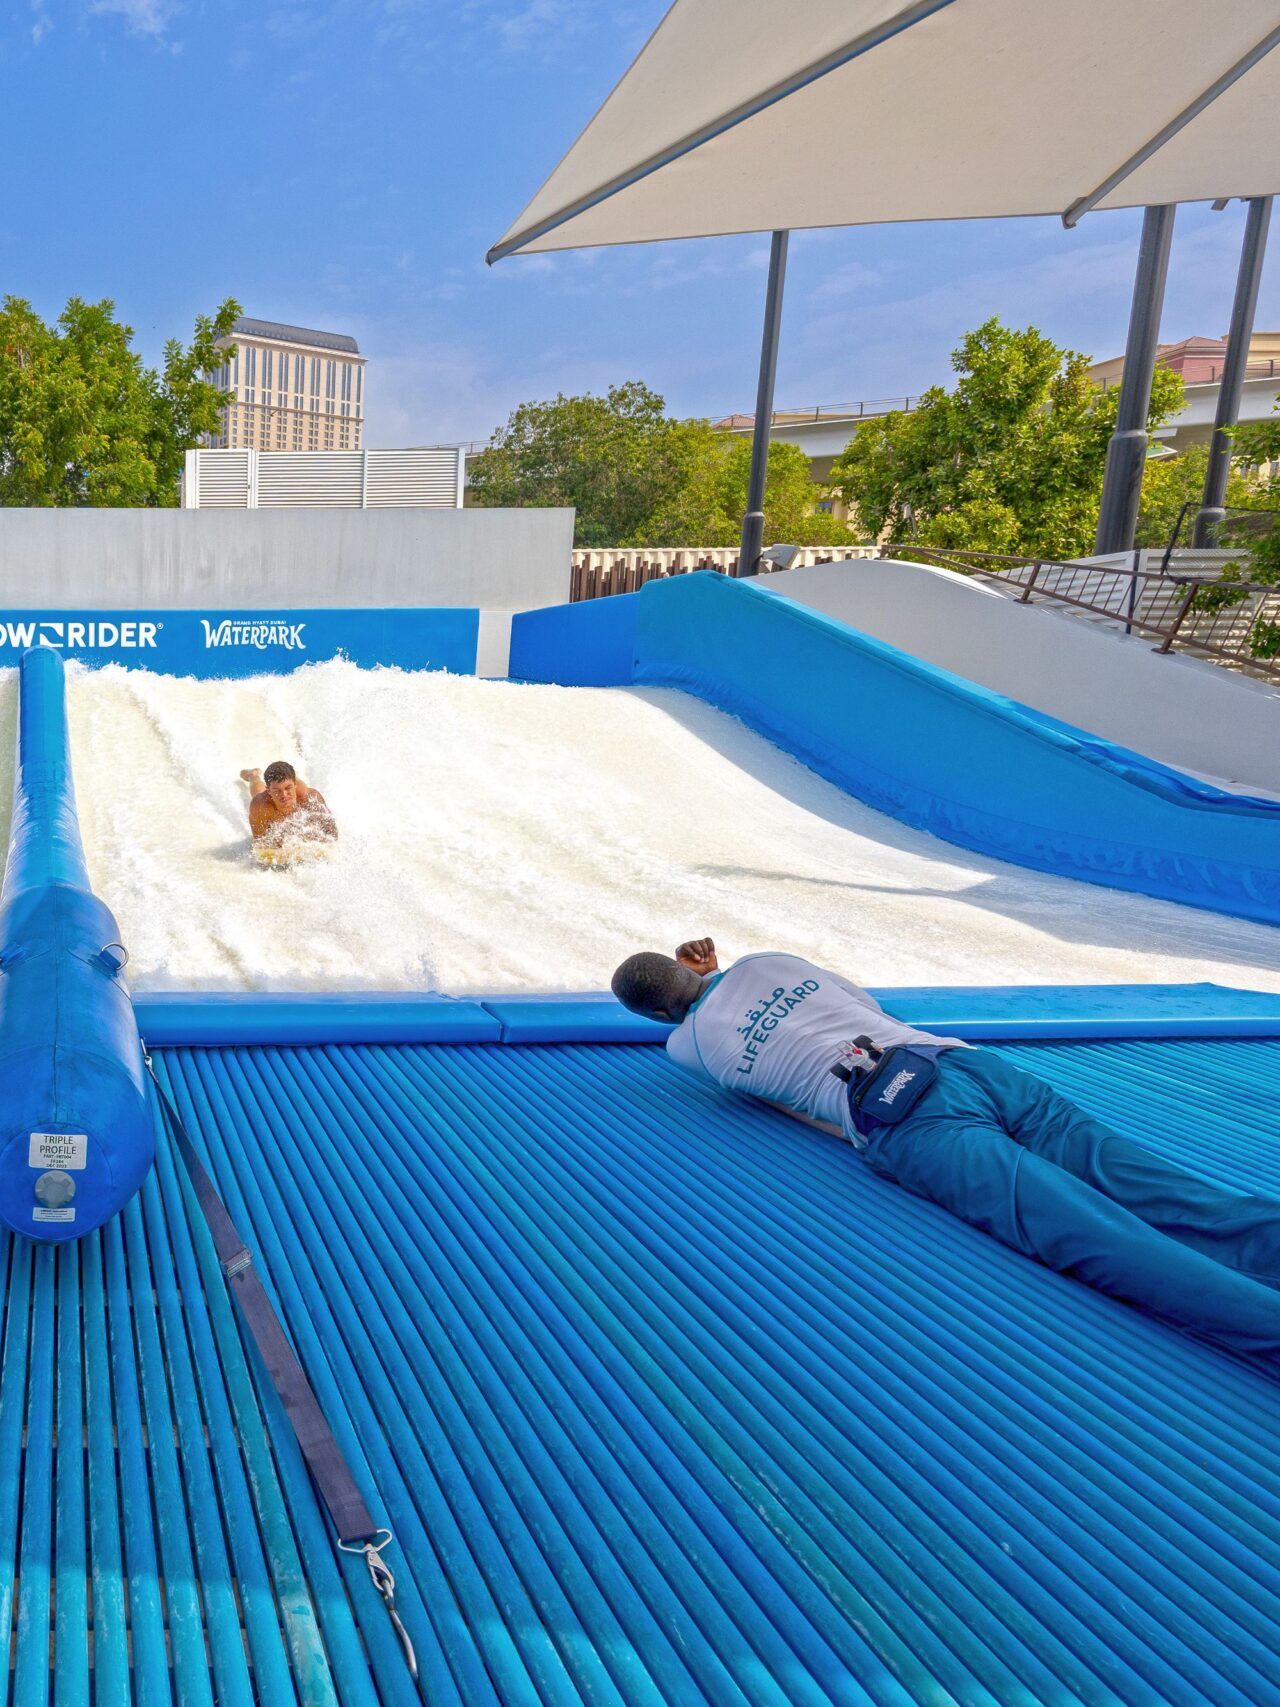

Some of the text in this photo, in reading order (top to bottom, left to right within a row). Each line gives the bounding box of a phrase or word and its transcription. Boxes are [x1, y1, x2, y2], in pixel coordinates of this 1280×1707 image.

[200, 619, 306, 650] WATERPARK
[736, 987, 785, 1041] منقذ
[736, 979, 820, 1075] LIFEGUARD
[878, 1069, 916, 1105] WATERPARK
[39, 1144, 77, 1155] PROFILE
[43, 1135, 74, 1145] TRIPLE
